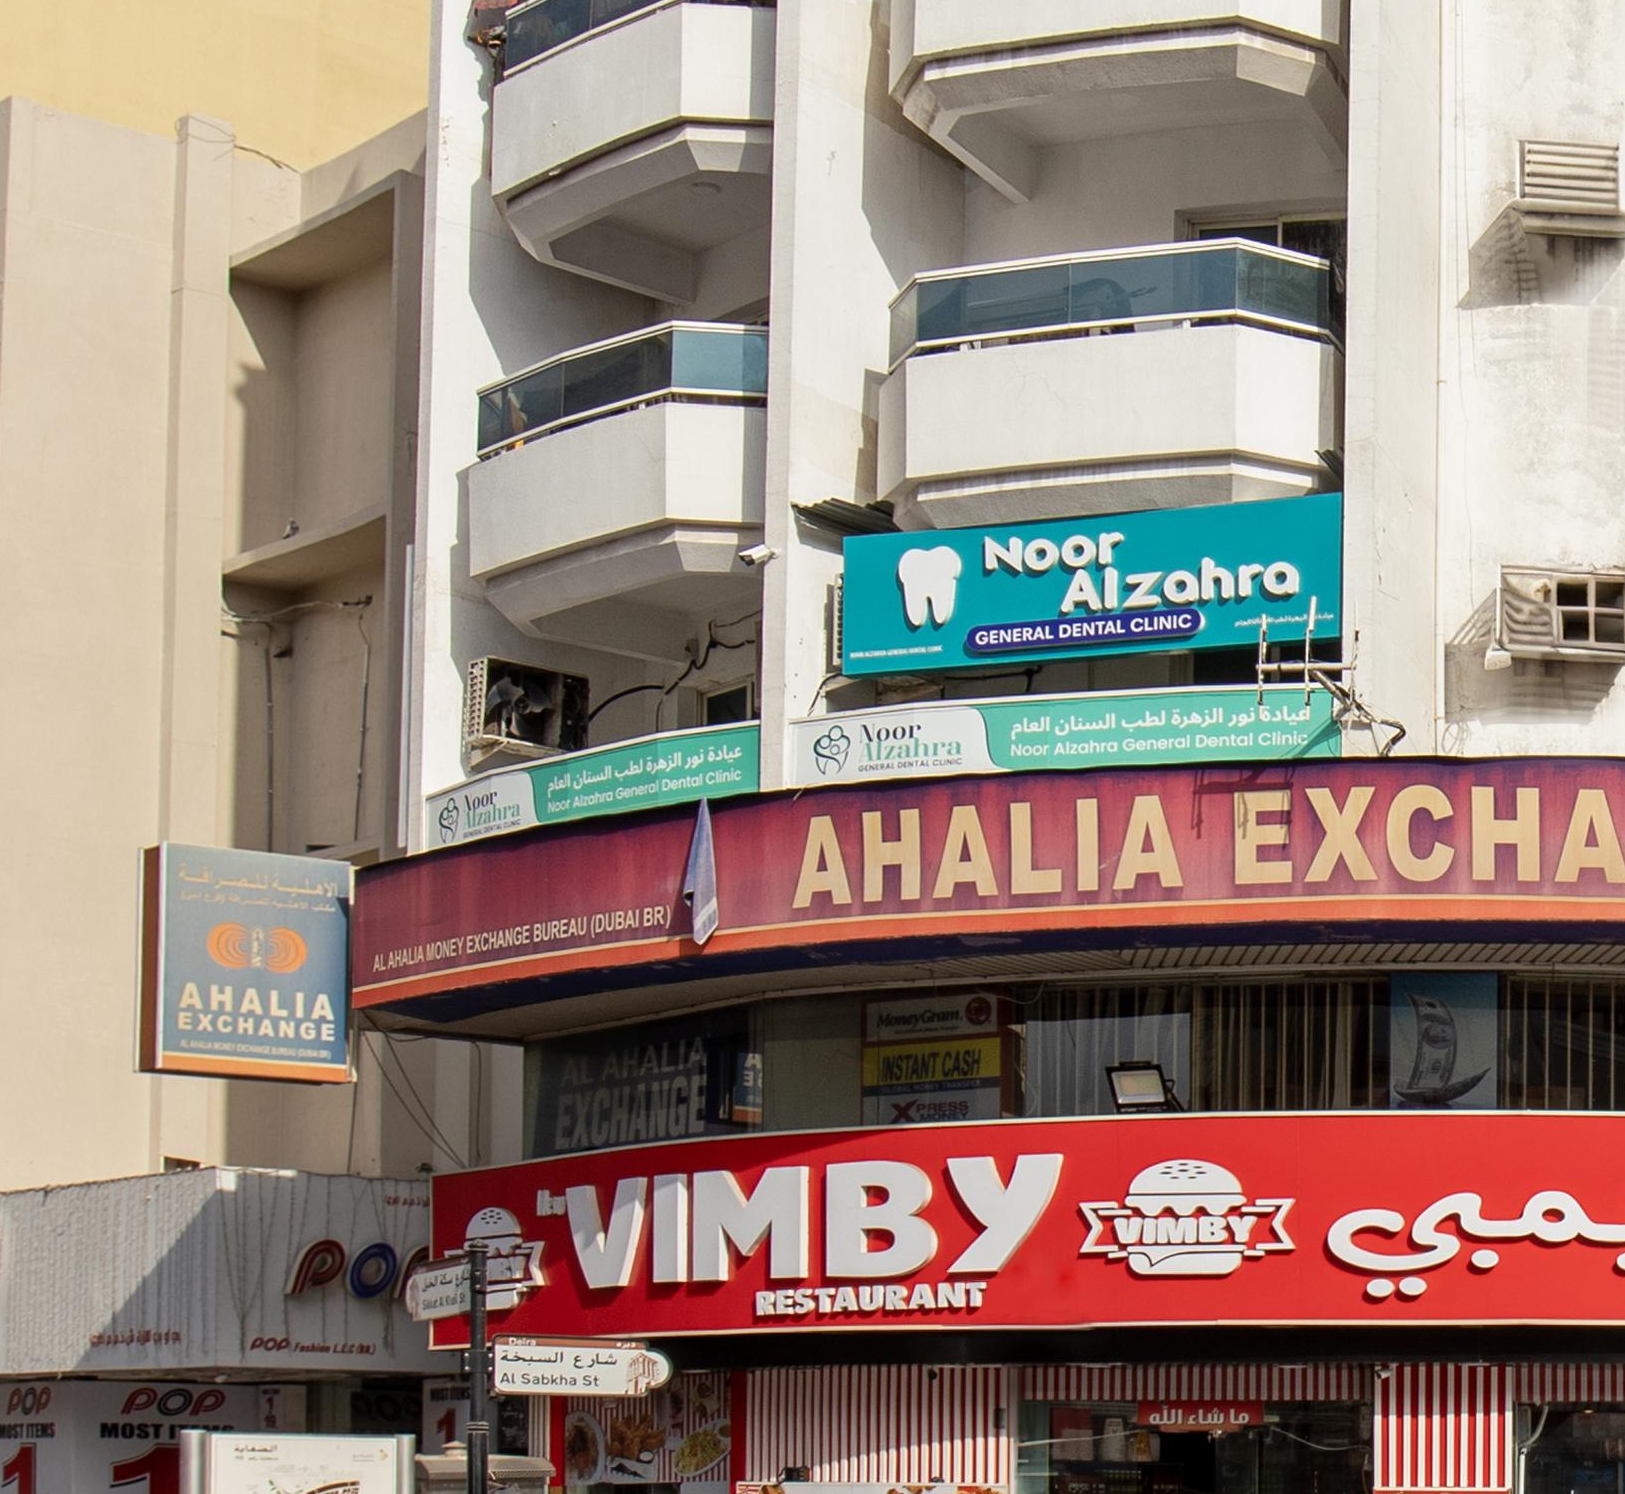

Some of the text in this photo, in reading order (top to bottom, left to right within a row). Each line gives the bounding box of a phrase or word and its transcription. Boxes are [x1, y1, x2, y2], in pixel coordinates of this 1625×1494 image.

[983, 531, 1124, 579] Noor
[1060, 556, 1301, 615] Alzahra
[974, 614, 1193, 646] GENERAL DENTAL CLINIC
[859, 721, 922, 742] Noor
[1011, 707, 1256, 740] نور الزهرة لطب السنان العام
[858, 737, 962, 762] Alzahra
[1010, 729, 1308, 757] Noor Alzahra General Dental Clinic
[547, 745, 742, 797] عيادة نور الزهرة لطب السنان العام
[858, 757, 963, 772] GENERAL DENTAL CLINIC
[464, 789, 498, 812] Noor
[547, 769, 742, 813] Noor Alzahra General Dental Clinic
[463, 801, 520, 827] Alzahra
[792, 793, 1186, 908] AHALIA
[374, 905, 671, 974] AL AHALIA MONEY EXCHANGE BUREAU (DUBAI BR)
[179, 982, 335, 1020] AHALIA
[177, 1012, 335, 1042] EXCHANGE
[606, 1035, 707, 1078] AHALIA
[881, 1048, 982, 1082] INSTANT CASH
[555, 1075, 708, 1151] EXCHANGE
[566, 1152, 1064, 1289] VIMBY
[1112, 1214, 1258, 1247] VIMBY
[754, 1280, 987, 1317] RESTAURANT
[249, 1337, 290, 1352] POP
[508, 1337, 536, 1347] Deira
[500, 1351, 618, 1369] شارع السبخة
[500, 1372, 599, 1387] Al Sabkha St
[6, 1387, 51, 1416] POP
[121, 1387, 226, 1416] POP
[26, 1423, 56, 1438] ITEMS
[100, 1423, 164, 1439] MOST
[1148, 1407, 1249, 1427] ما شاء الله
